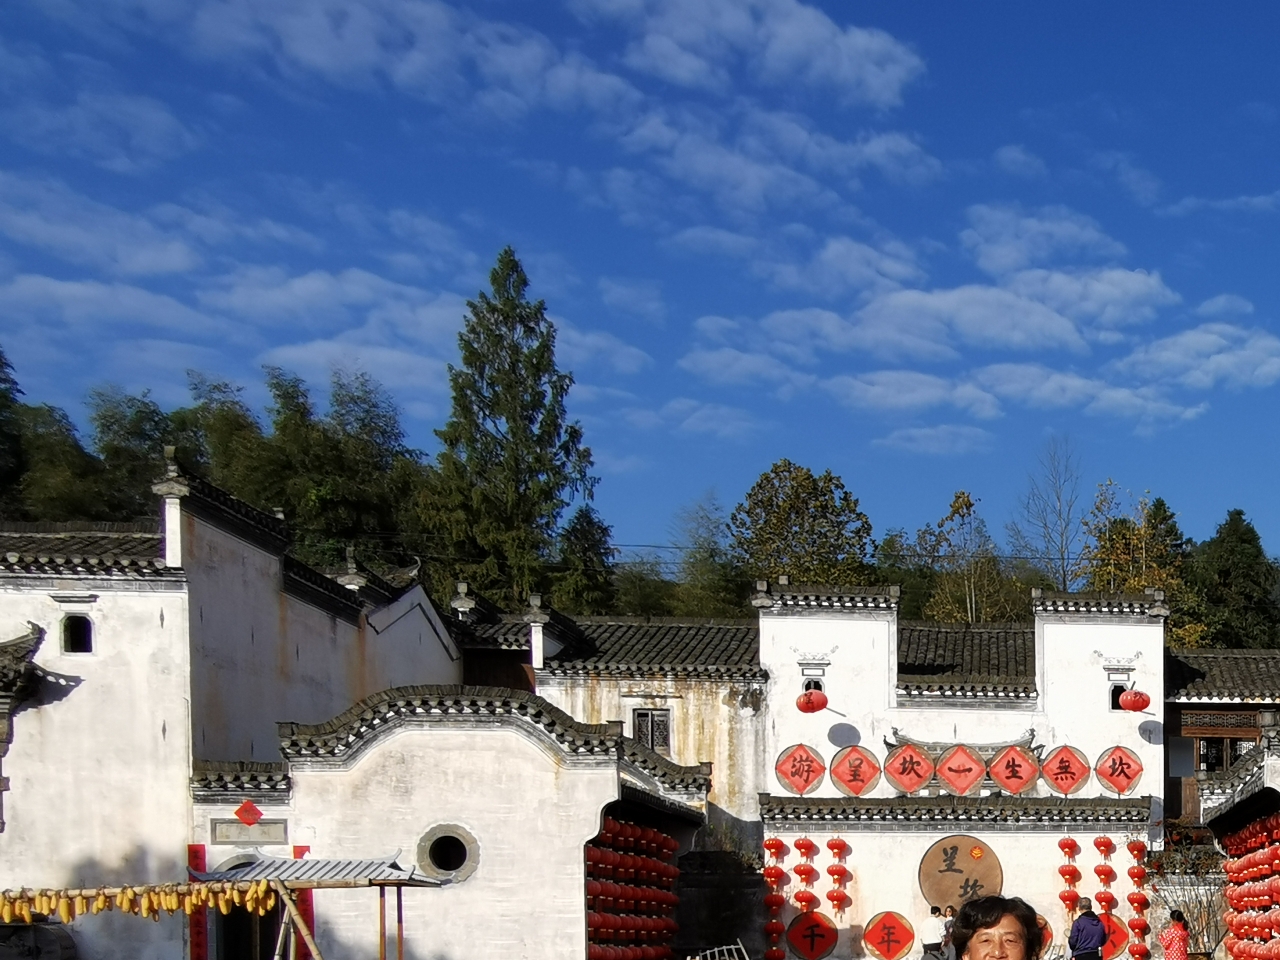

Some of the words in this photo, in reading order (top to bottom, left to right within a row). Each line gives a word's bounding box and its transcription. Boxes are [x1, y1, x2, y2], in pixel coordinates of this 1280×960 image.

[790, 753, 1133, 784] 游呈坎一生無坎
